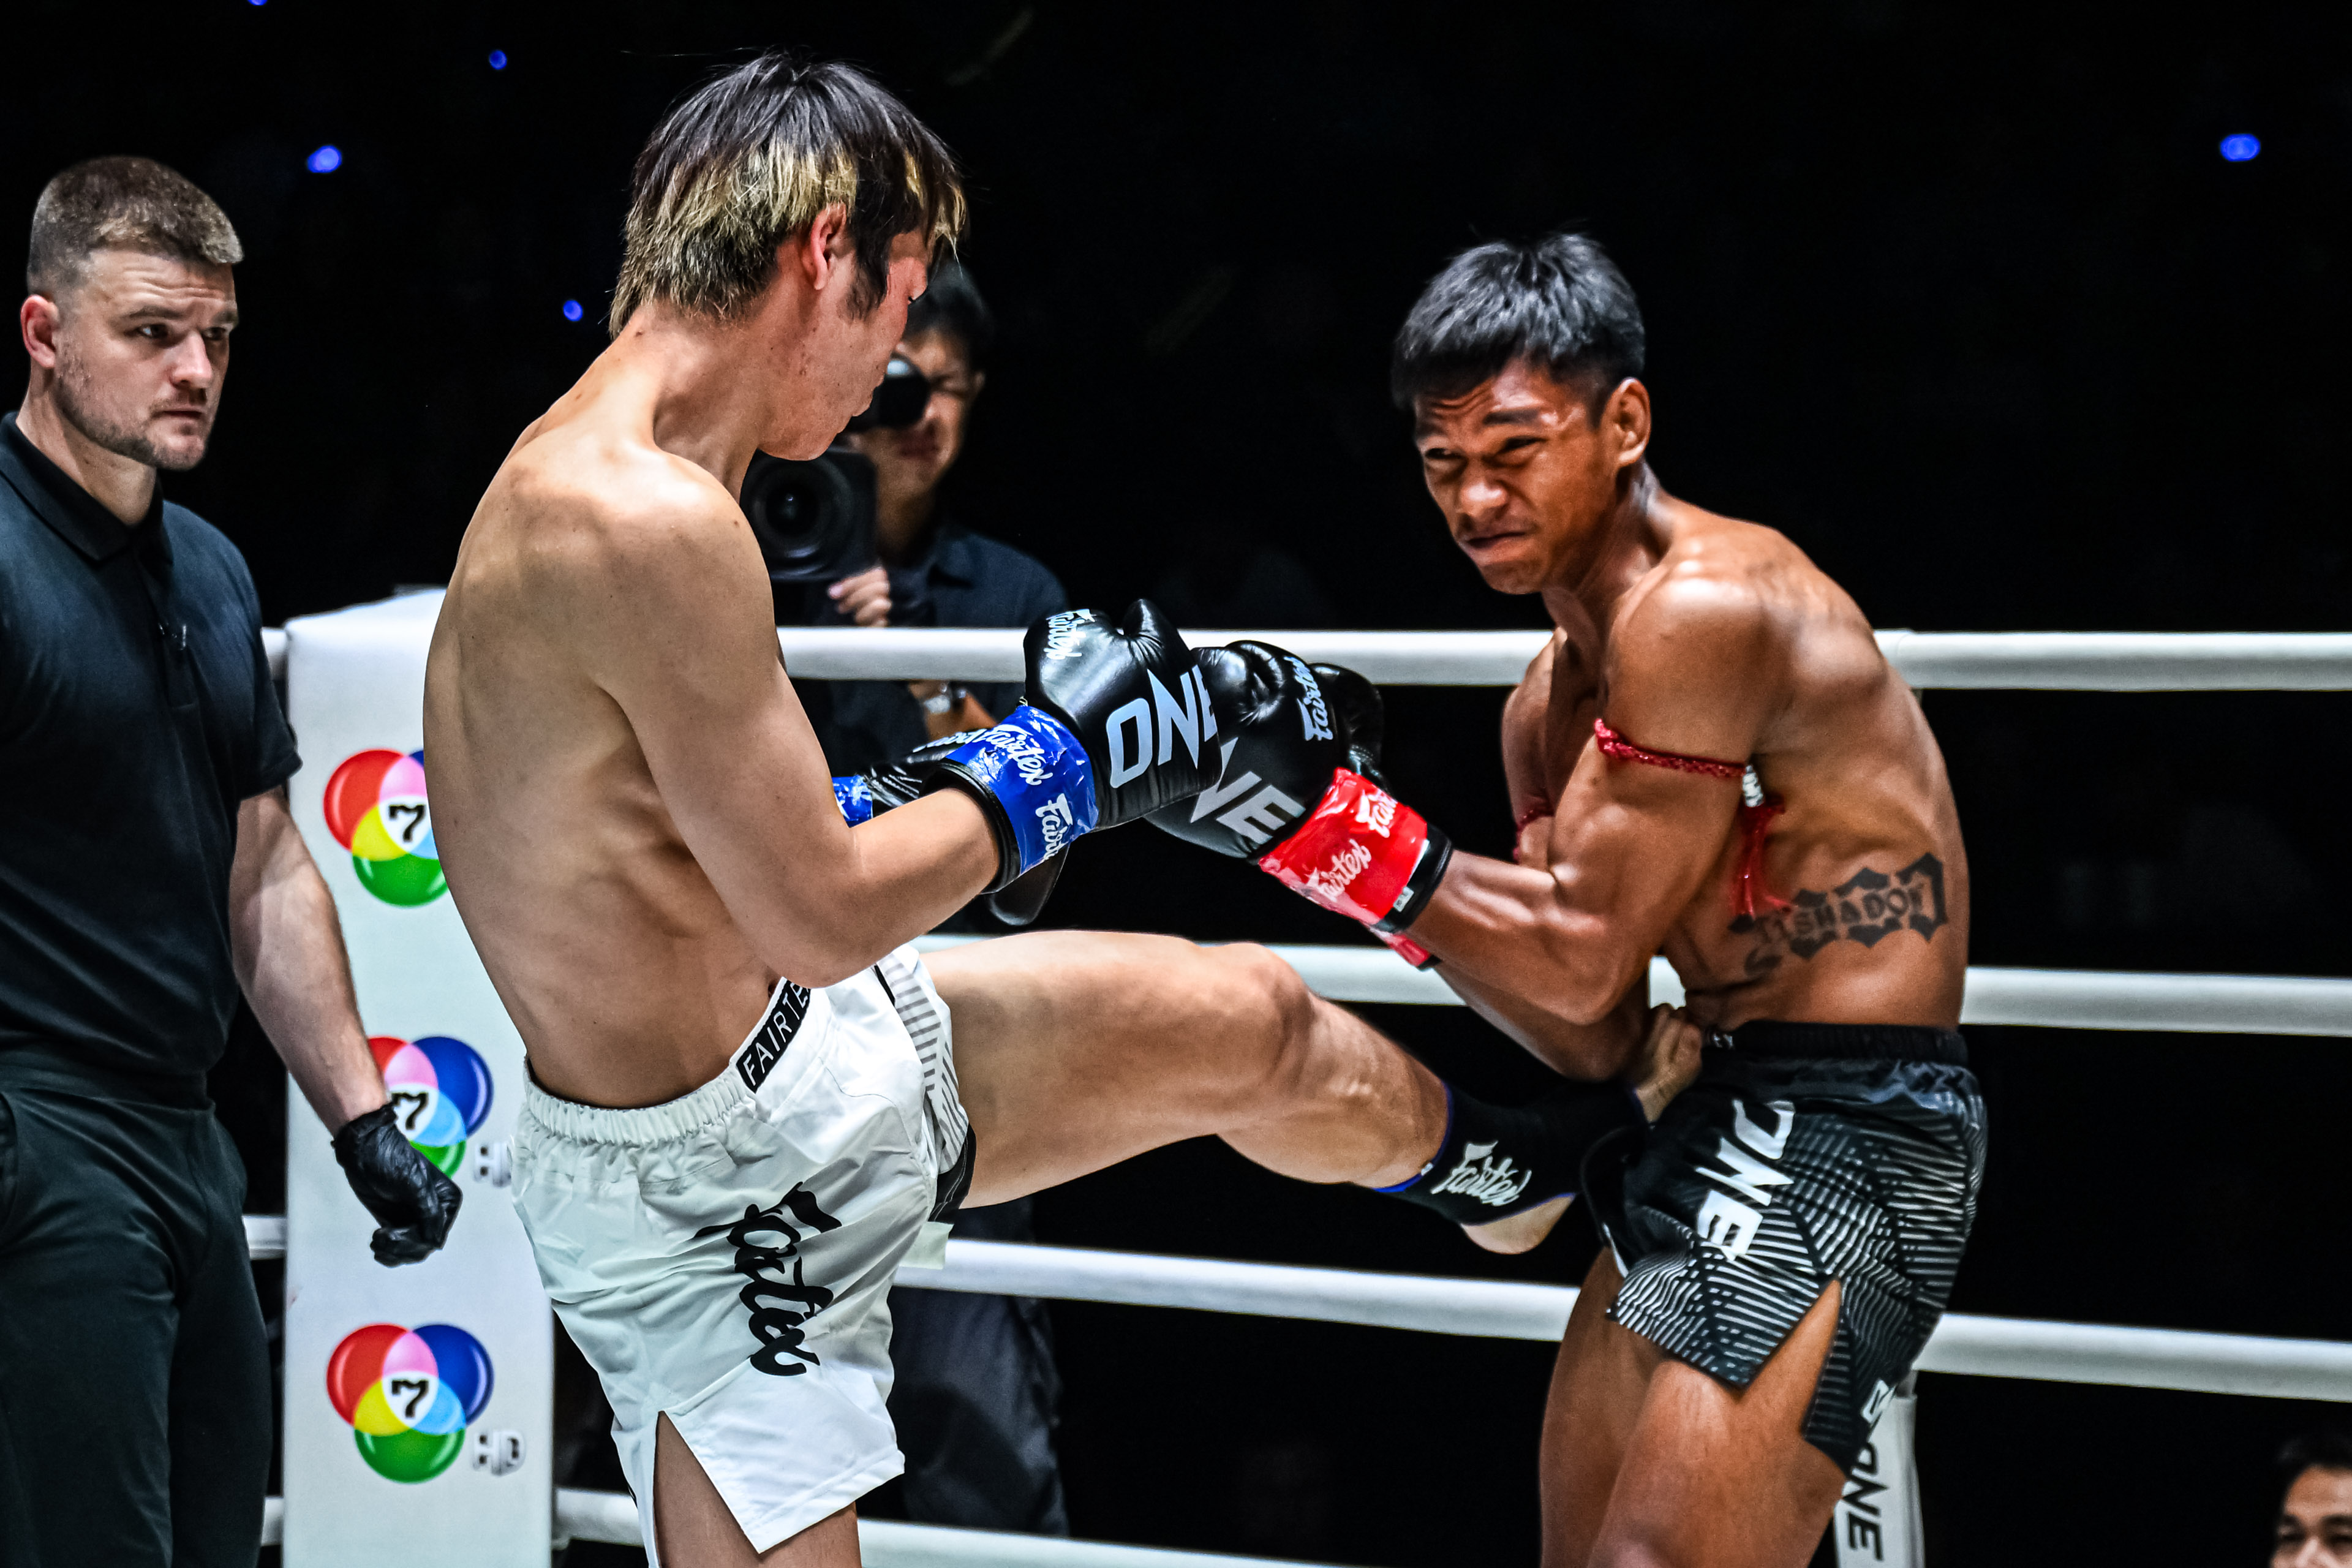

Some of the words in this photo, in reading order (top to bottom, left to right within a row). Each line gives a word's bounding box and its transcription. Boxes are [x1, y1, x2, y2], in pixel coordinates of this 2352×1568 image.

[973, 724, 1054, 785] Fairtex
[1190, 737, 1306, 839] NE
[388, 804, 426, 843] 7
[1303, 838, 1372, 902] Fairtex
[742, 982, 810, 1087] FAIRTE
[391, 1092, 429, 1130] 7
[391, 1380, 429, 1417] 7
